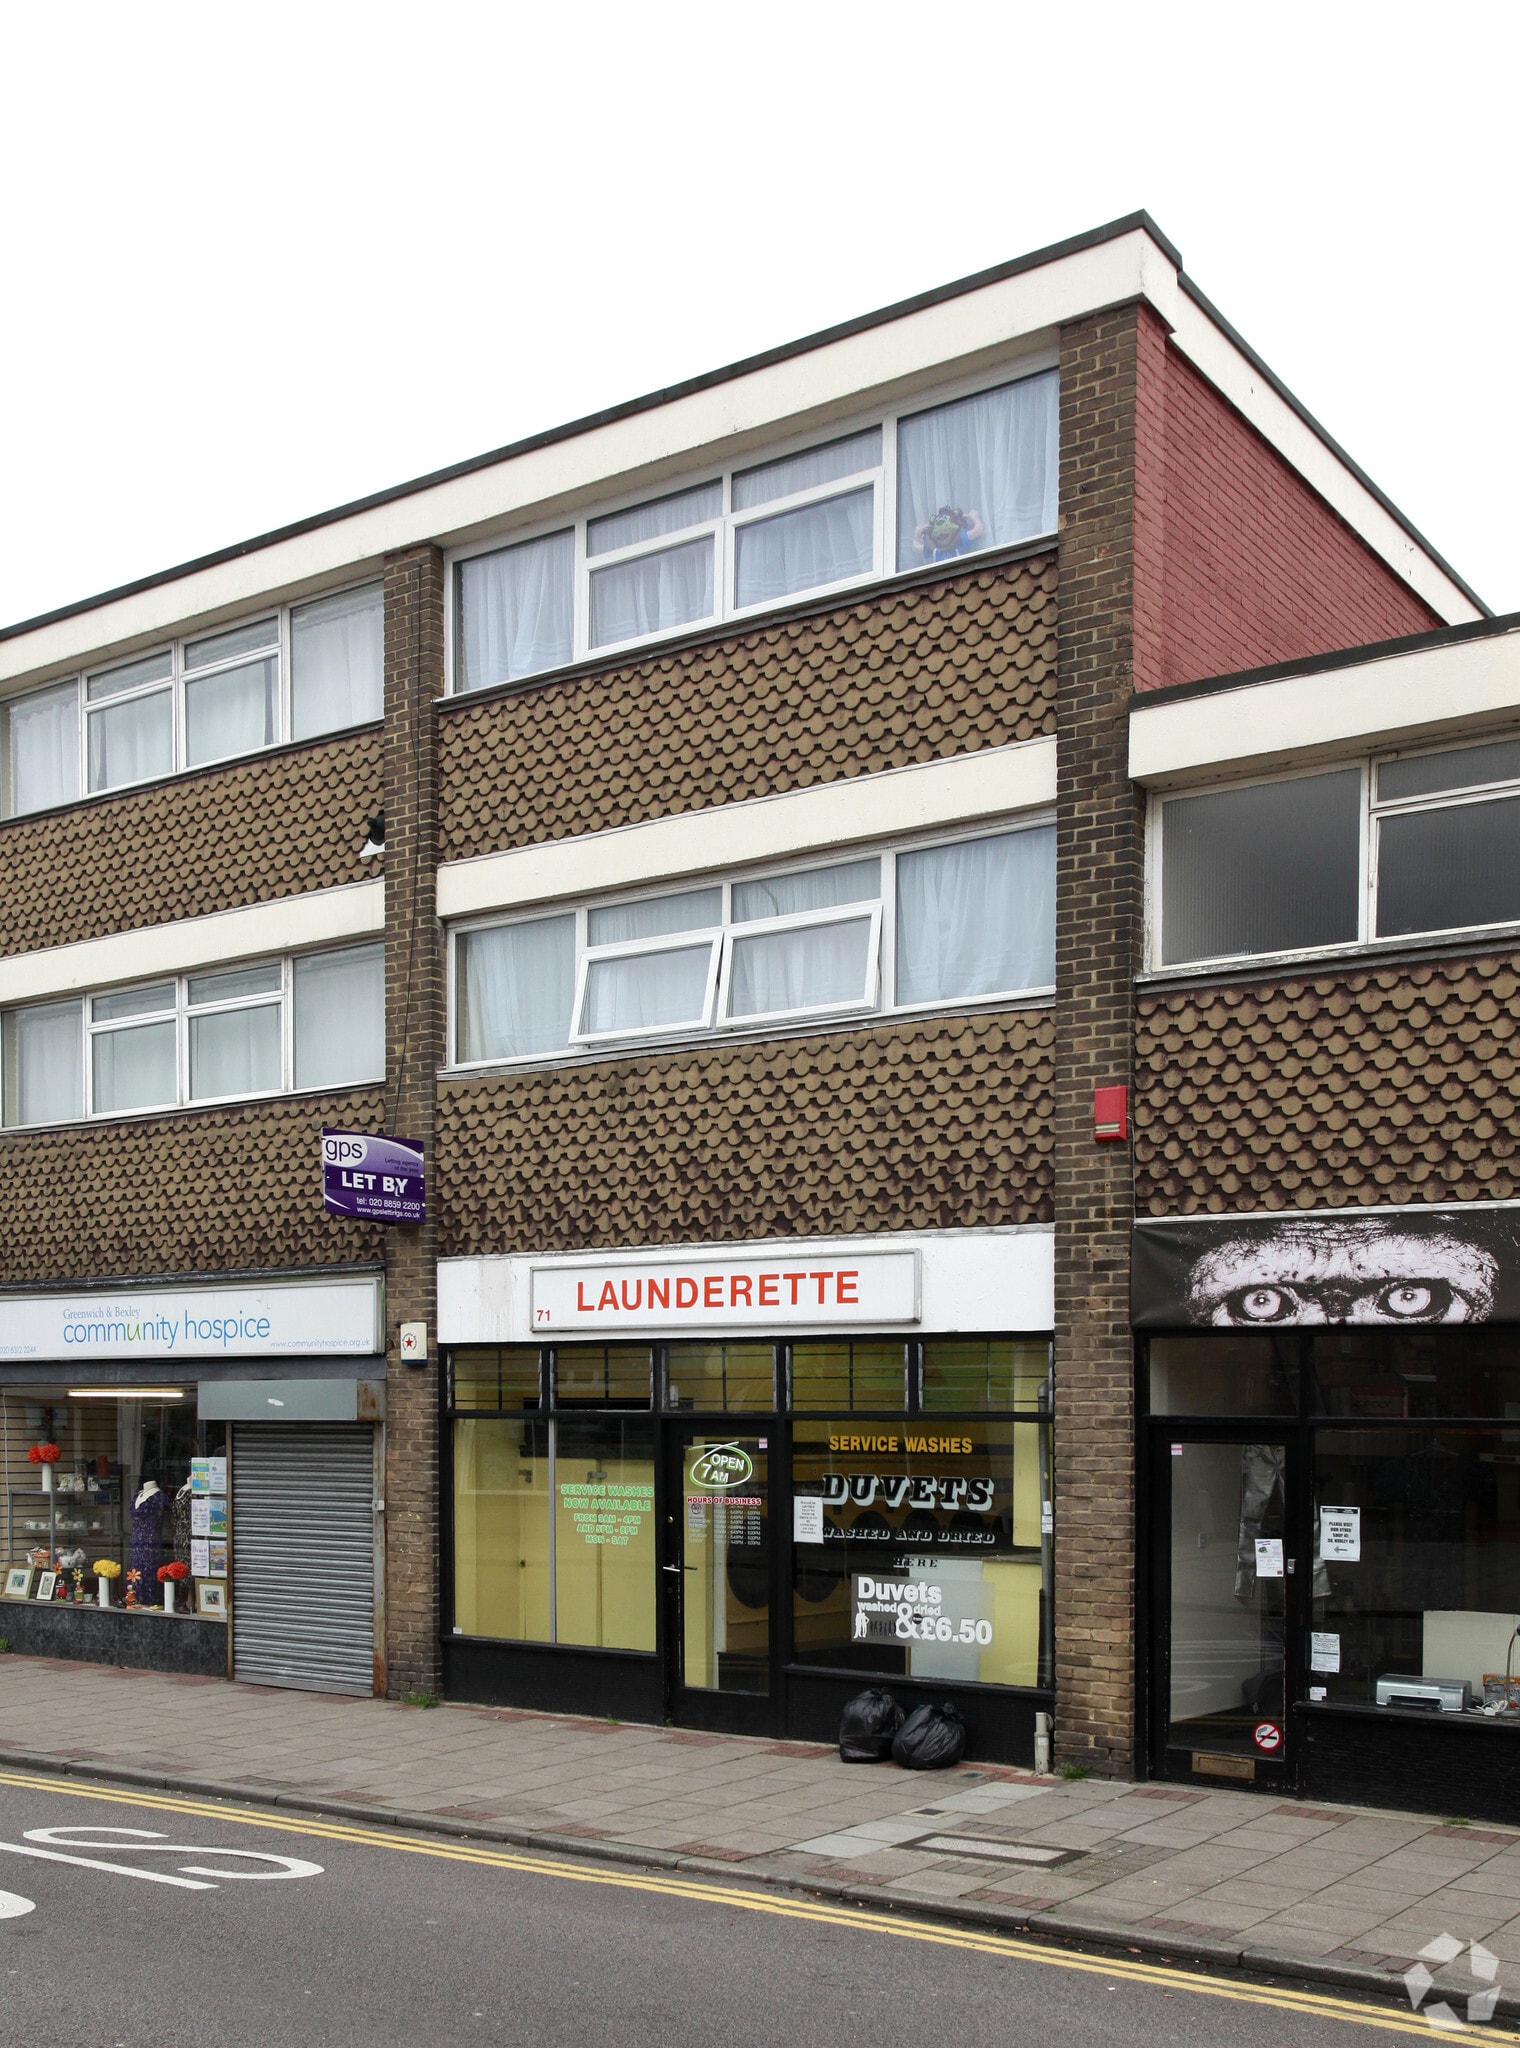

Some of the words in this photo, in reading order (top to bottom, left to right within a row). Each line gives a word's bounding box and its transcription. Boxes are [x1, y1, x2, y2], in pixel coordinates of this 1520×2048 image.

[325, 1139, 363, 1162] gps
[341, 1171, 377, 1191] LET
[382, 1175, 409, 1194] BY
[368, 1197, 383, 1207] 020
[383, 1199, 402, 1209] 8859
[402, 1201, 421, 1211] 2200
[577, 1270, 859, 1311] LAUNDERETTE
[63, 1306, 104, 1320] Greenwich
[105, 1306, 112, 1318] &
[114, 1305, 141, 1319] Bexley
[536, 1309, 551, 1322] 71
[63, 1312, 179, 1349] community
[184, 1309, 271, 1348] hospice
[829, 1435, 899, 1452] SERVICE
[904, 1436, 973, 1454] WASHES
[710, 1453, 745, 1472] OPEN
[701, 1463, 712, 1479] 7
[709, 1470, 729, 1484] AM
[560, 1483, 606, 1497] SERVICE
[607, 1485, 655, 1498] WASHES
[821, 1473, 995, 1512] DUVETS
[563, 1497, 589, 1509] NOW
[590, 1498, 652, 1511] AVAILABLE
[687, 1496, 713, 1504] HOURS
[713, 1496, 723, 1504] OF
[724, 1497, 762, 1506] BUSINESS
[573, 1513, 597, 1523] FROM
[623, 1515, 641, 1525] 4PM
[576, 1524, 595, 1533] AND
[823, 1528, 891, 1540] WASHED
[895, 1529, 933, 1542] AND
[937, 1531, 996, 1545] DRIED
[585, 1534, 605, 1544] MON
[611, 1536, 629, 1545] SAT
[893, 1557, 939, 1568] HERE
[858, 1576, 943, 1604] Duvets
[857, 1601, 897, 1613] washed
[896, 1602, 920, 1639] &
[913, 1604, 941, 1616] dried
[920, 1616, 993, 1645] £6.50
